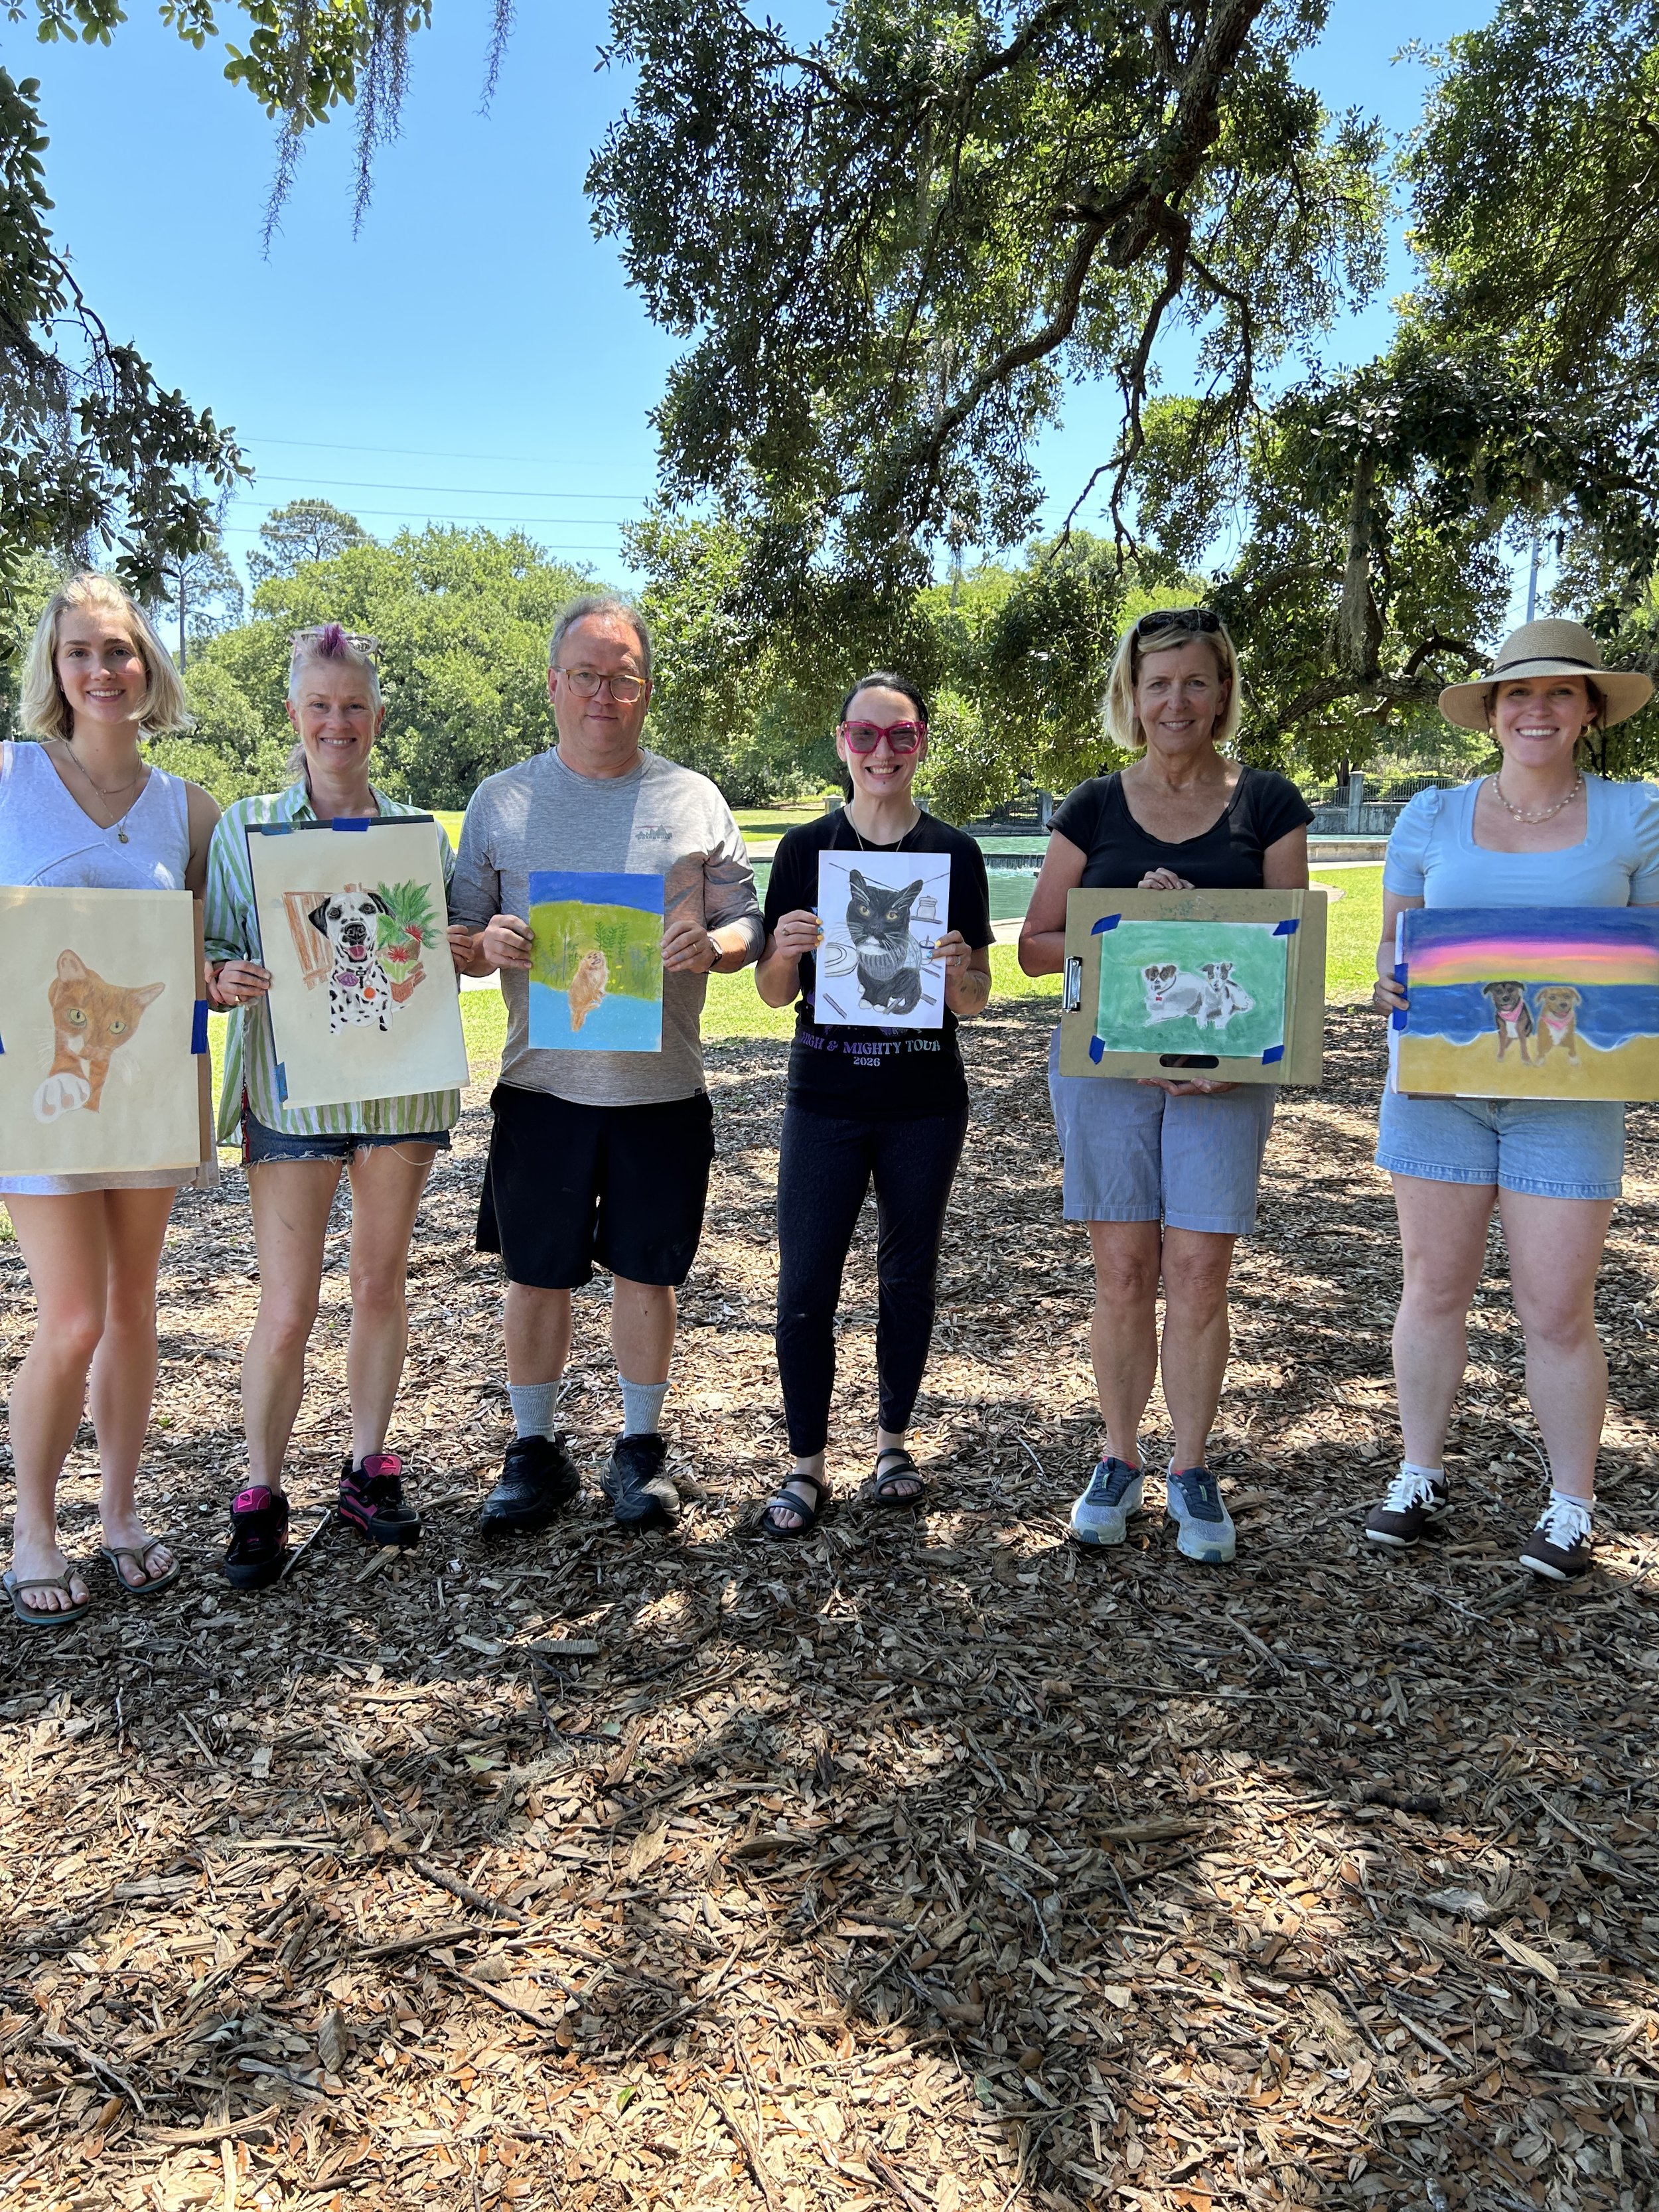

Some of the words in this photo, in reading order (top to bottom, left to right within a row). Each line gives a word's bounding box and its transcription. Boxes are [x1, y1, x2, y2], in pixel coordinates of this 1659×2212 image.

[827, 1041, 838, 1051] &
[843, 1041, 901, 1055] MIGHTY
[905, 1039, 940, 1052] TOUR
[853, 1056, 881, 1067] 2026
